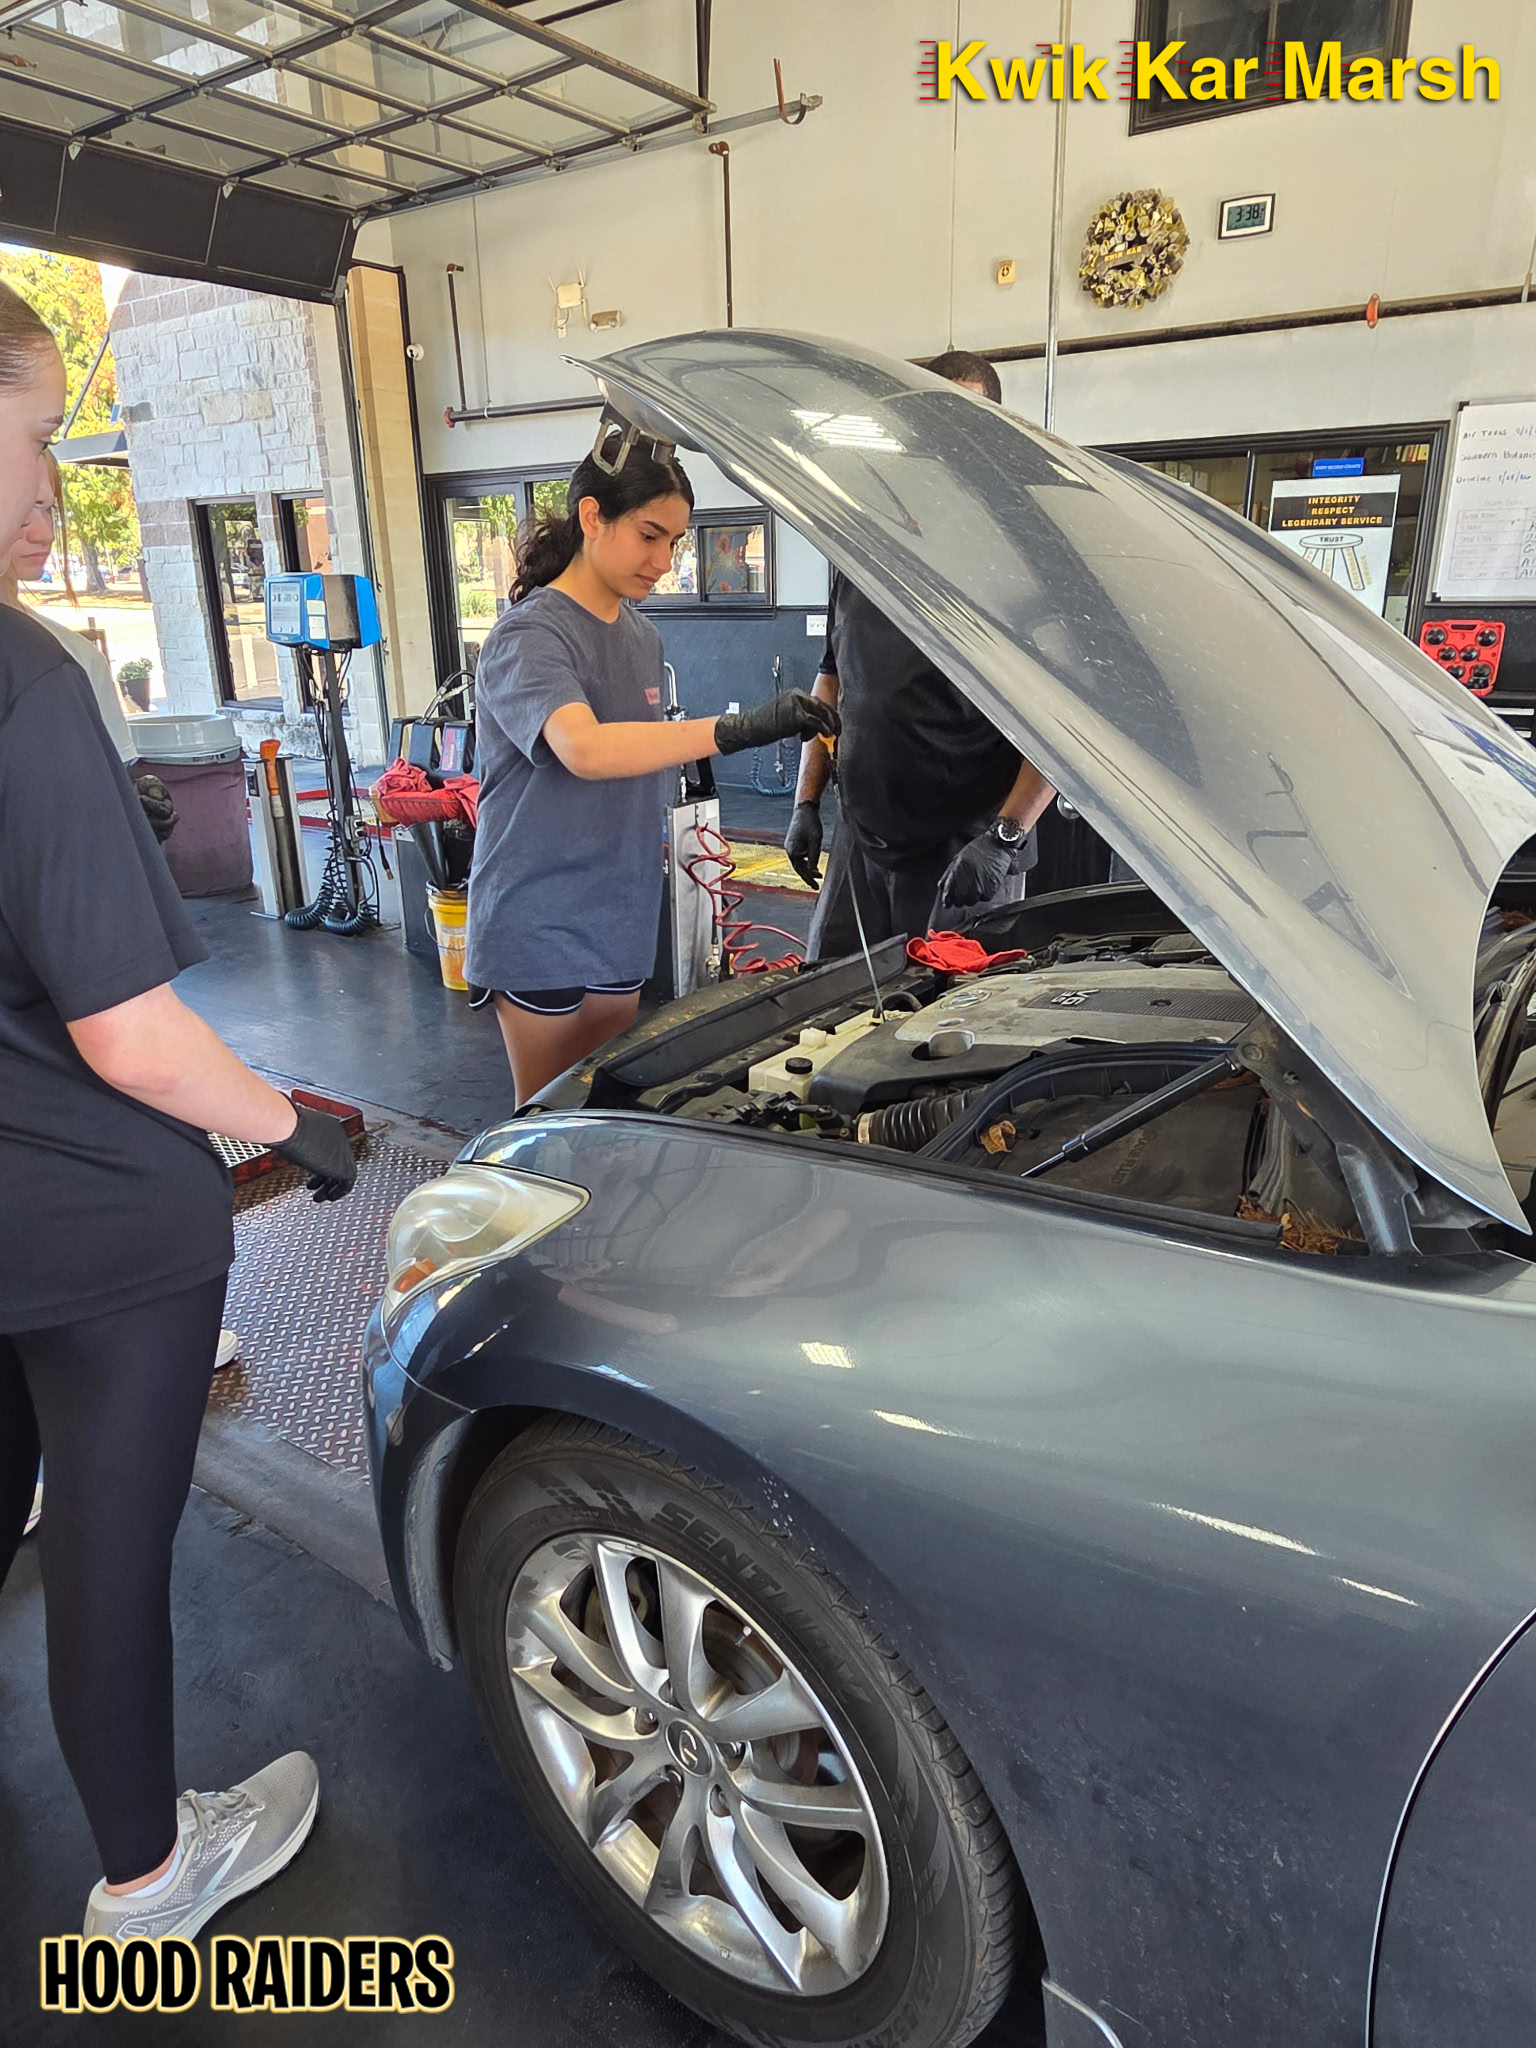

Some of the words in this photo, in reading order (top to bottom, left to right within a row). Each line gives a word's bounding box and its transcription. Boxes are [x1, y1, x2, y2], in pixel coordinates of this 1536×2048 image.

[1308, 495, 1361, 505] INTEGRITY
[1311, 506, 1355, 515] RESPECT
[1282, 518, 1338, 527] LEGENDARY
[1340, 516, 1383, 525] SERVICE
